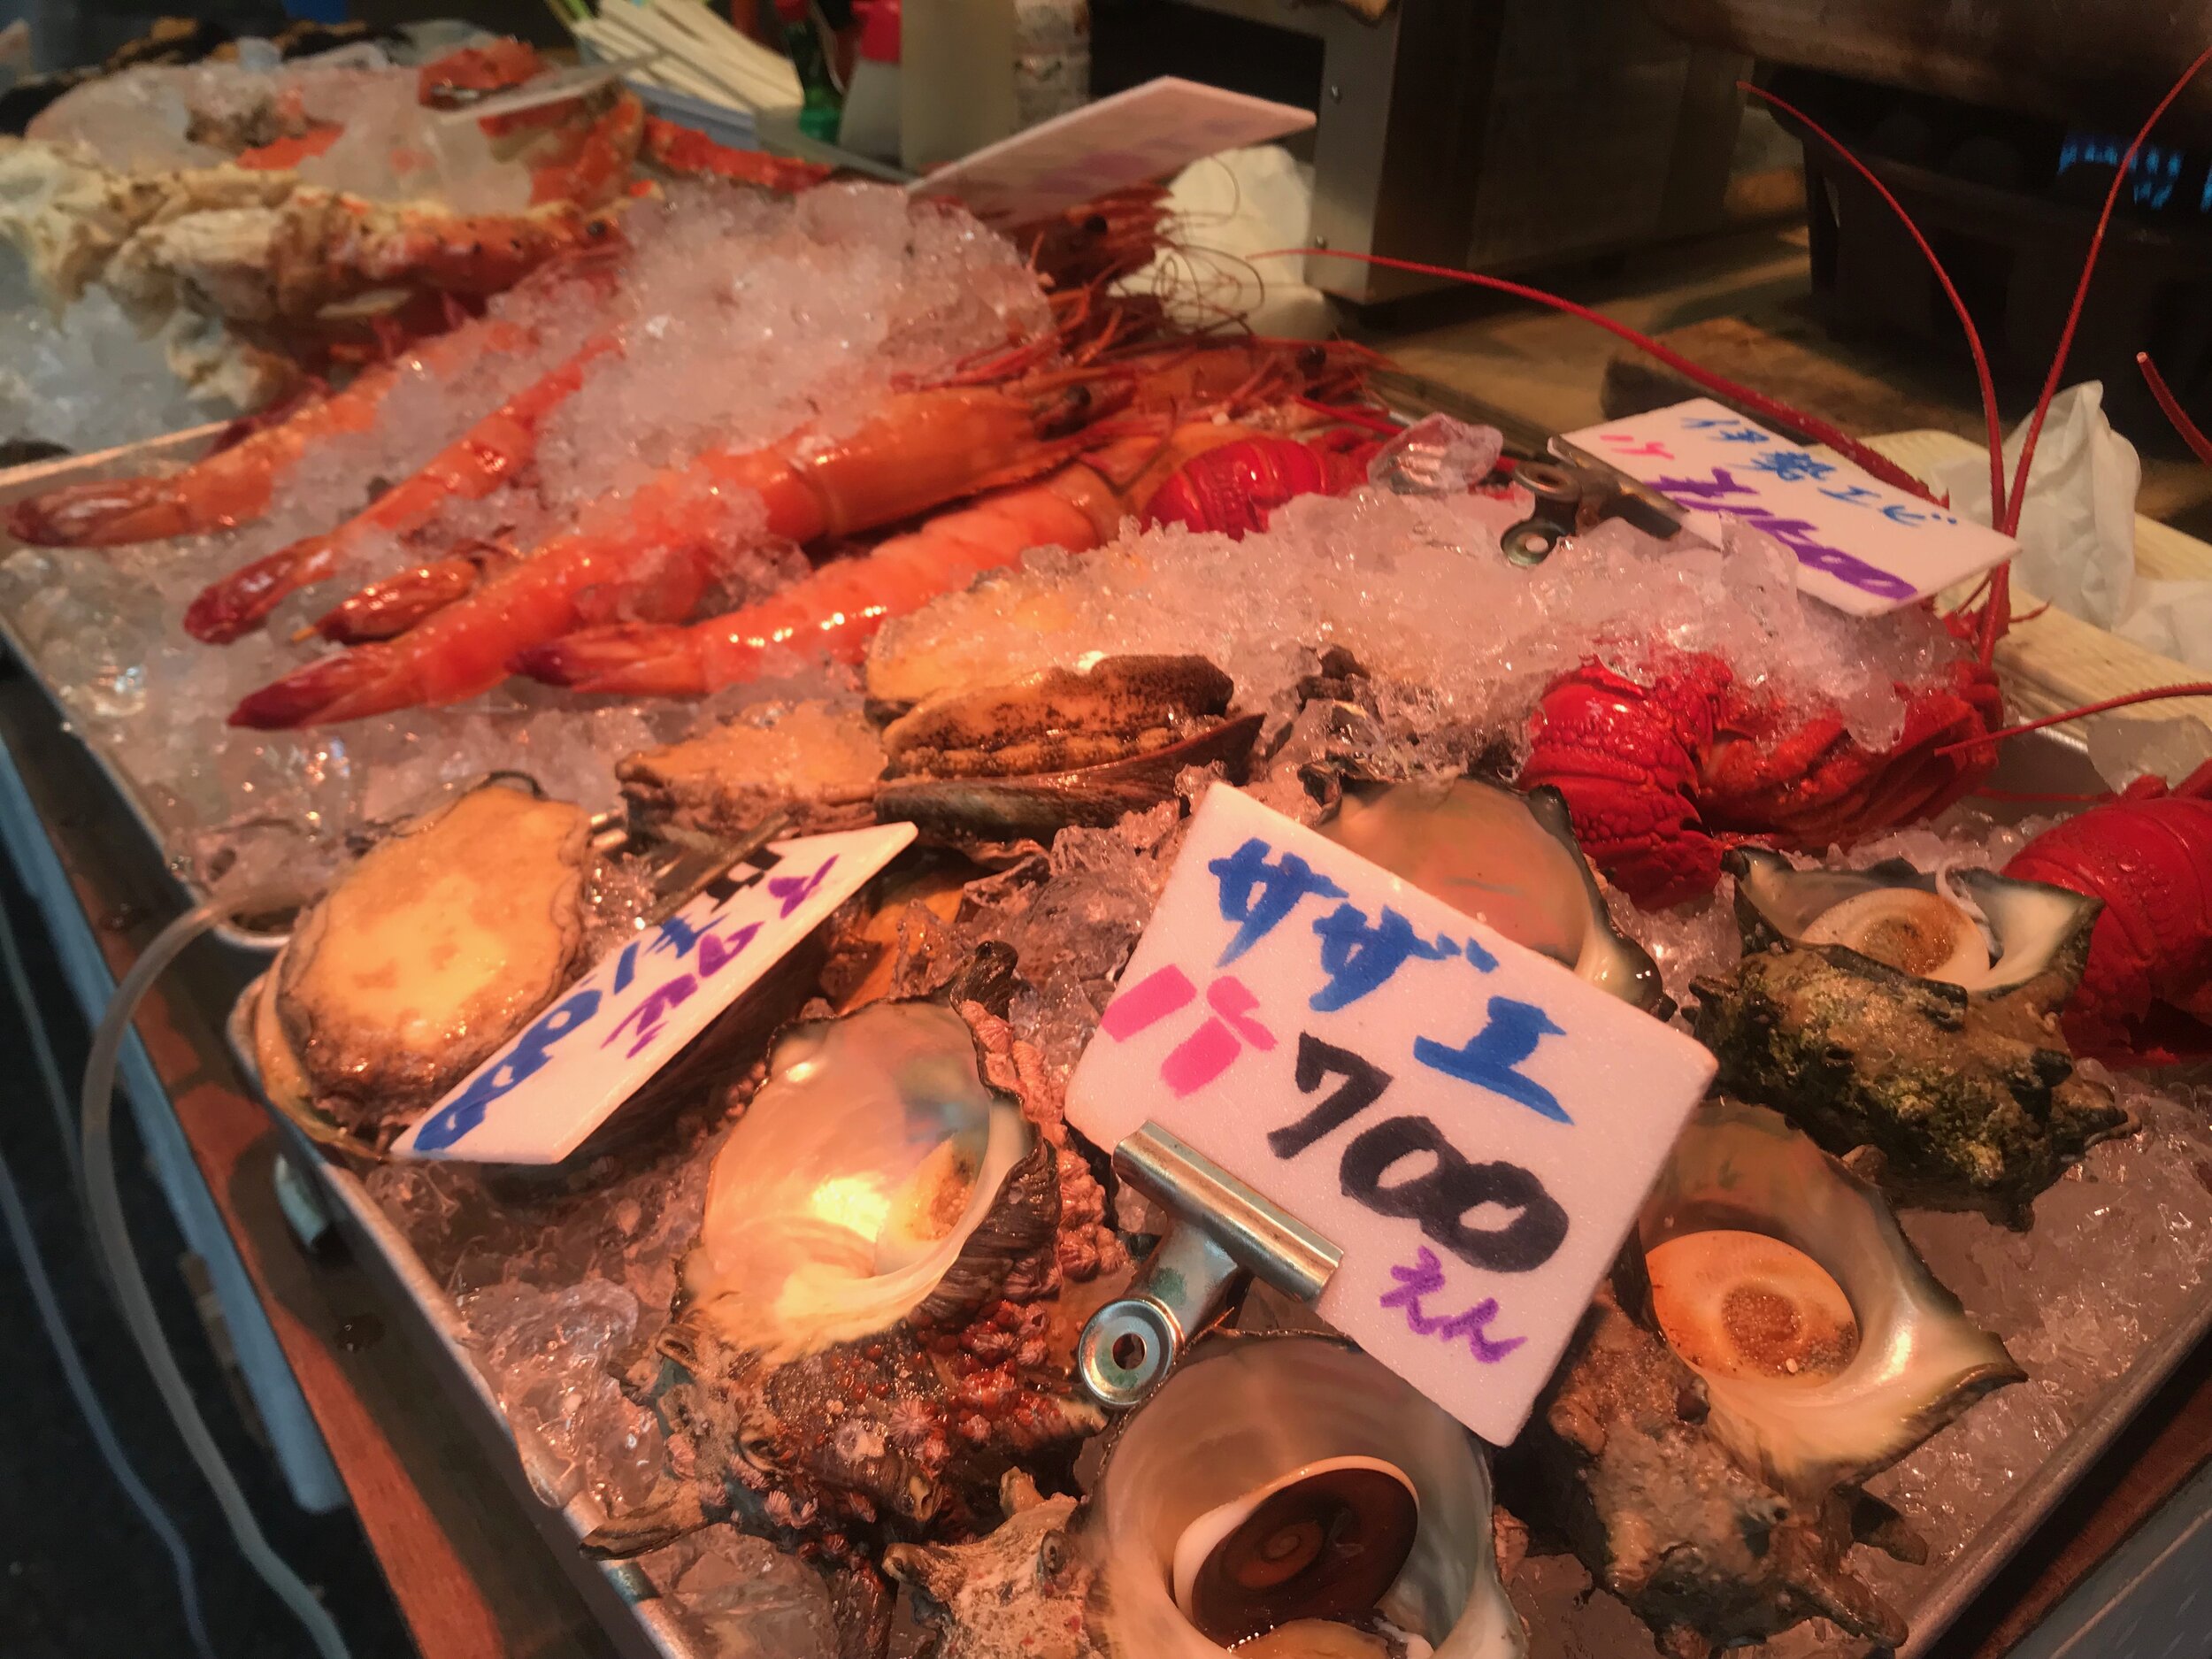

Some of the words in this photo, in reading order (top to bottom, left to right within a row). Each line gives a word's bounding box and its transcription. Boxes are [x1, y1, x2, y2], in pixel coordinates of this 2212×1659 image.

[1209, 836, 1574, 1125] サザエ
[1267, 1031, 1570, 1272] 700
[1380, 1246, 1528, 1363] えん
